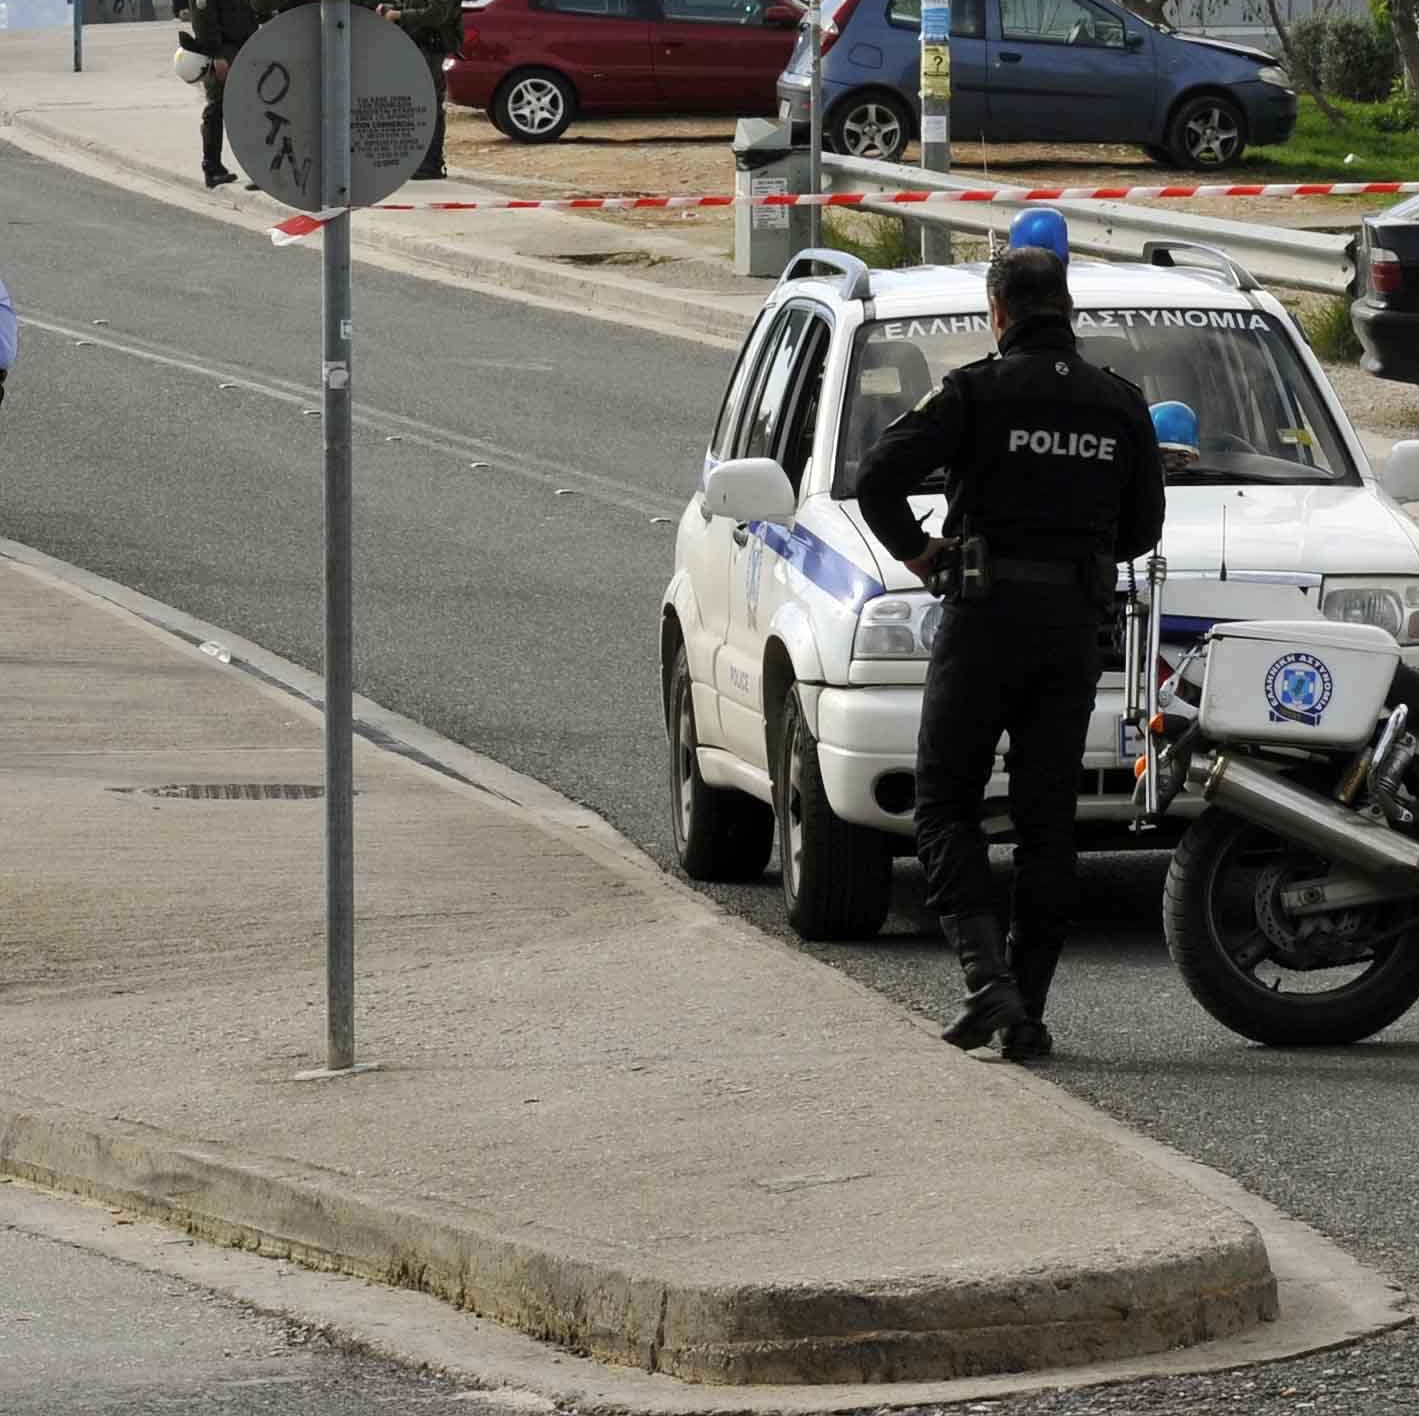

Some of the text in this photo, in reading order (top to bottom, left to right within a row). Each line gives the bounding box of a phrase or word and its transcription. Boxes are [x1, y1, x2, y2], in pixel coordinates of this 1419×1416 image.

[884, 310, 1270, 340] ΕΛΛΗΝ ΑΣΤΥΝΟΜΙΑ
[1009, 430, 1117, 460] POLICE
